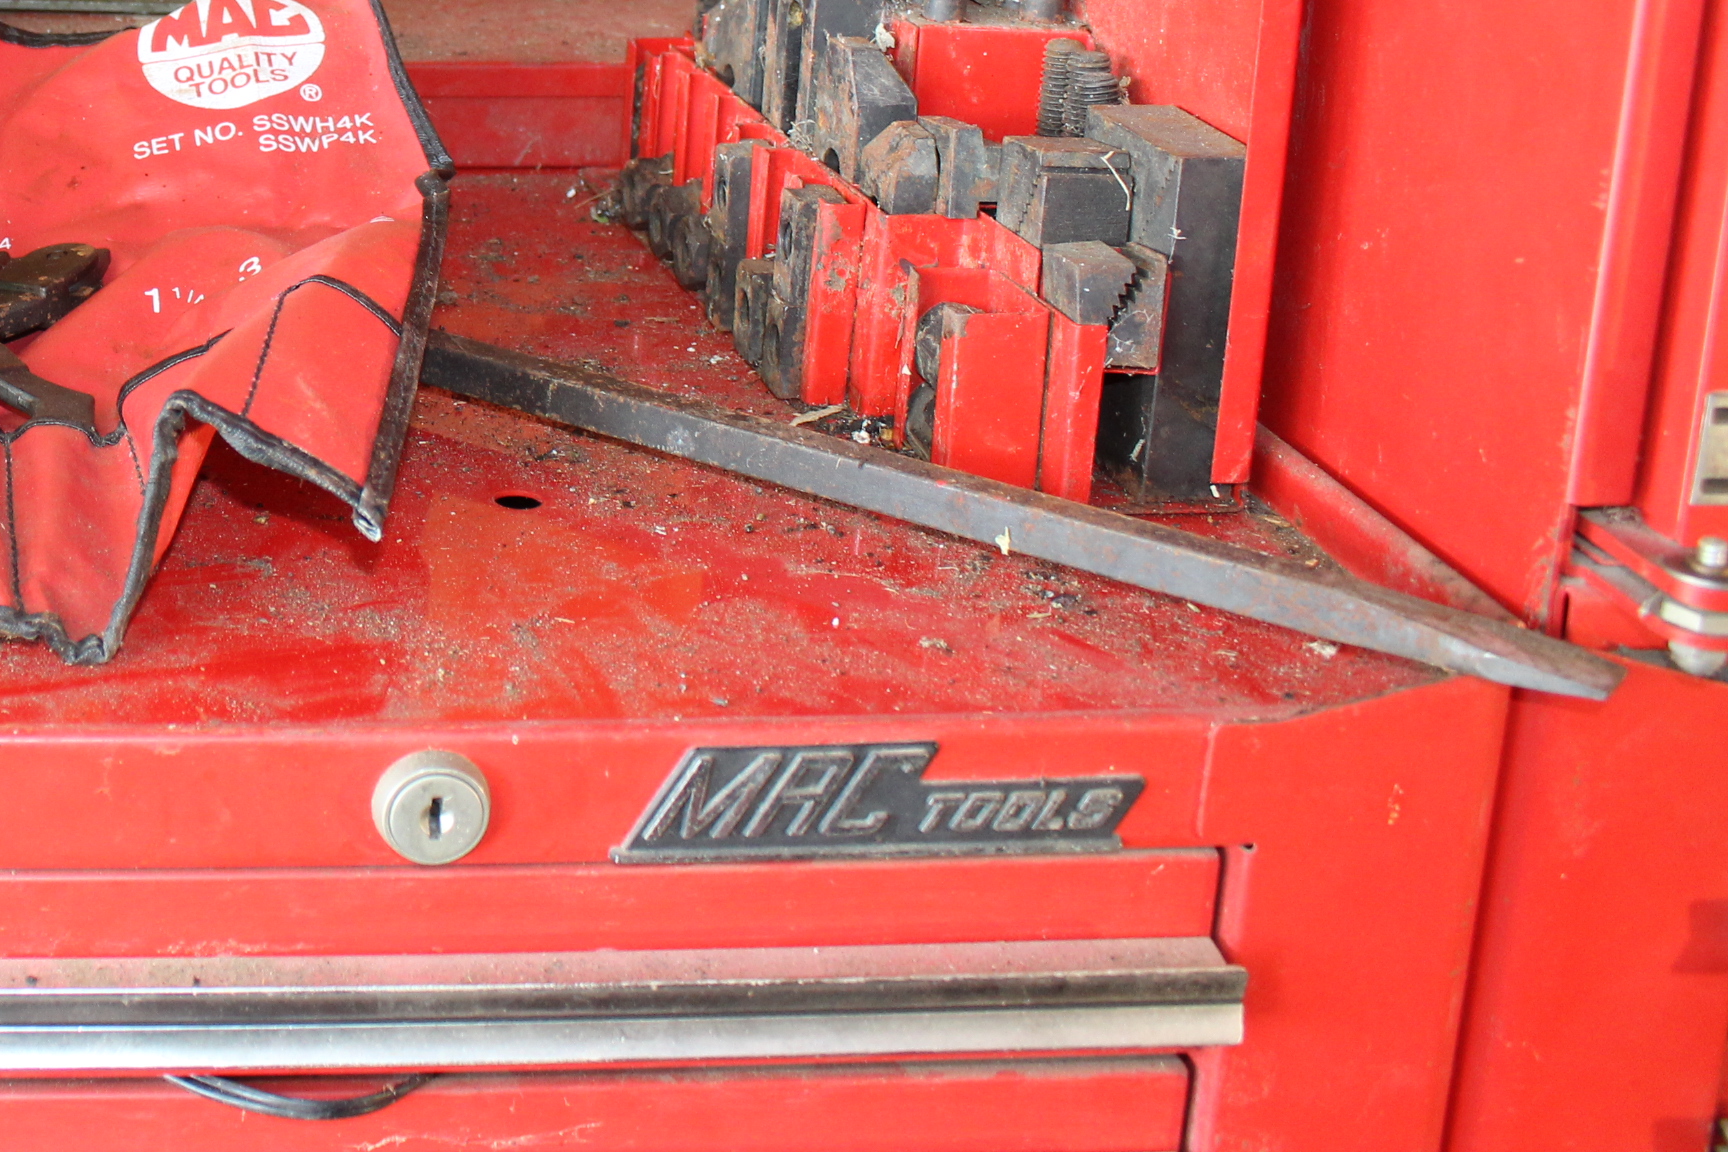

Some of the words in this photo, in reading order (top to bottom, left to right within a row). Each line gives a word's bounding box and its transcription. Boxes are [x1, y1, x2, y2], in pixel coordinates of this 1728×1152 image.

[173, 51, 298, 84] QUALITY
[189, 68, 289, 98] TOOLS
[133, 133, 185, 159] SET
[194, 121, 244, 146] NO.
[252, 113, 374, 133] SSWH4K
[259, 129, 378, 152] SSWP4K
[144, 288, 160, 313] 1
[641, 750, 930, 840] MAC
[918, 788, 1124, 833] TOOLS
